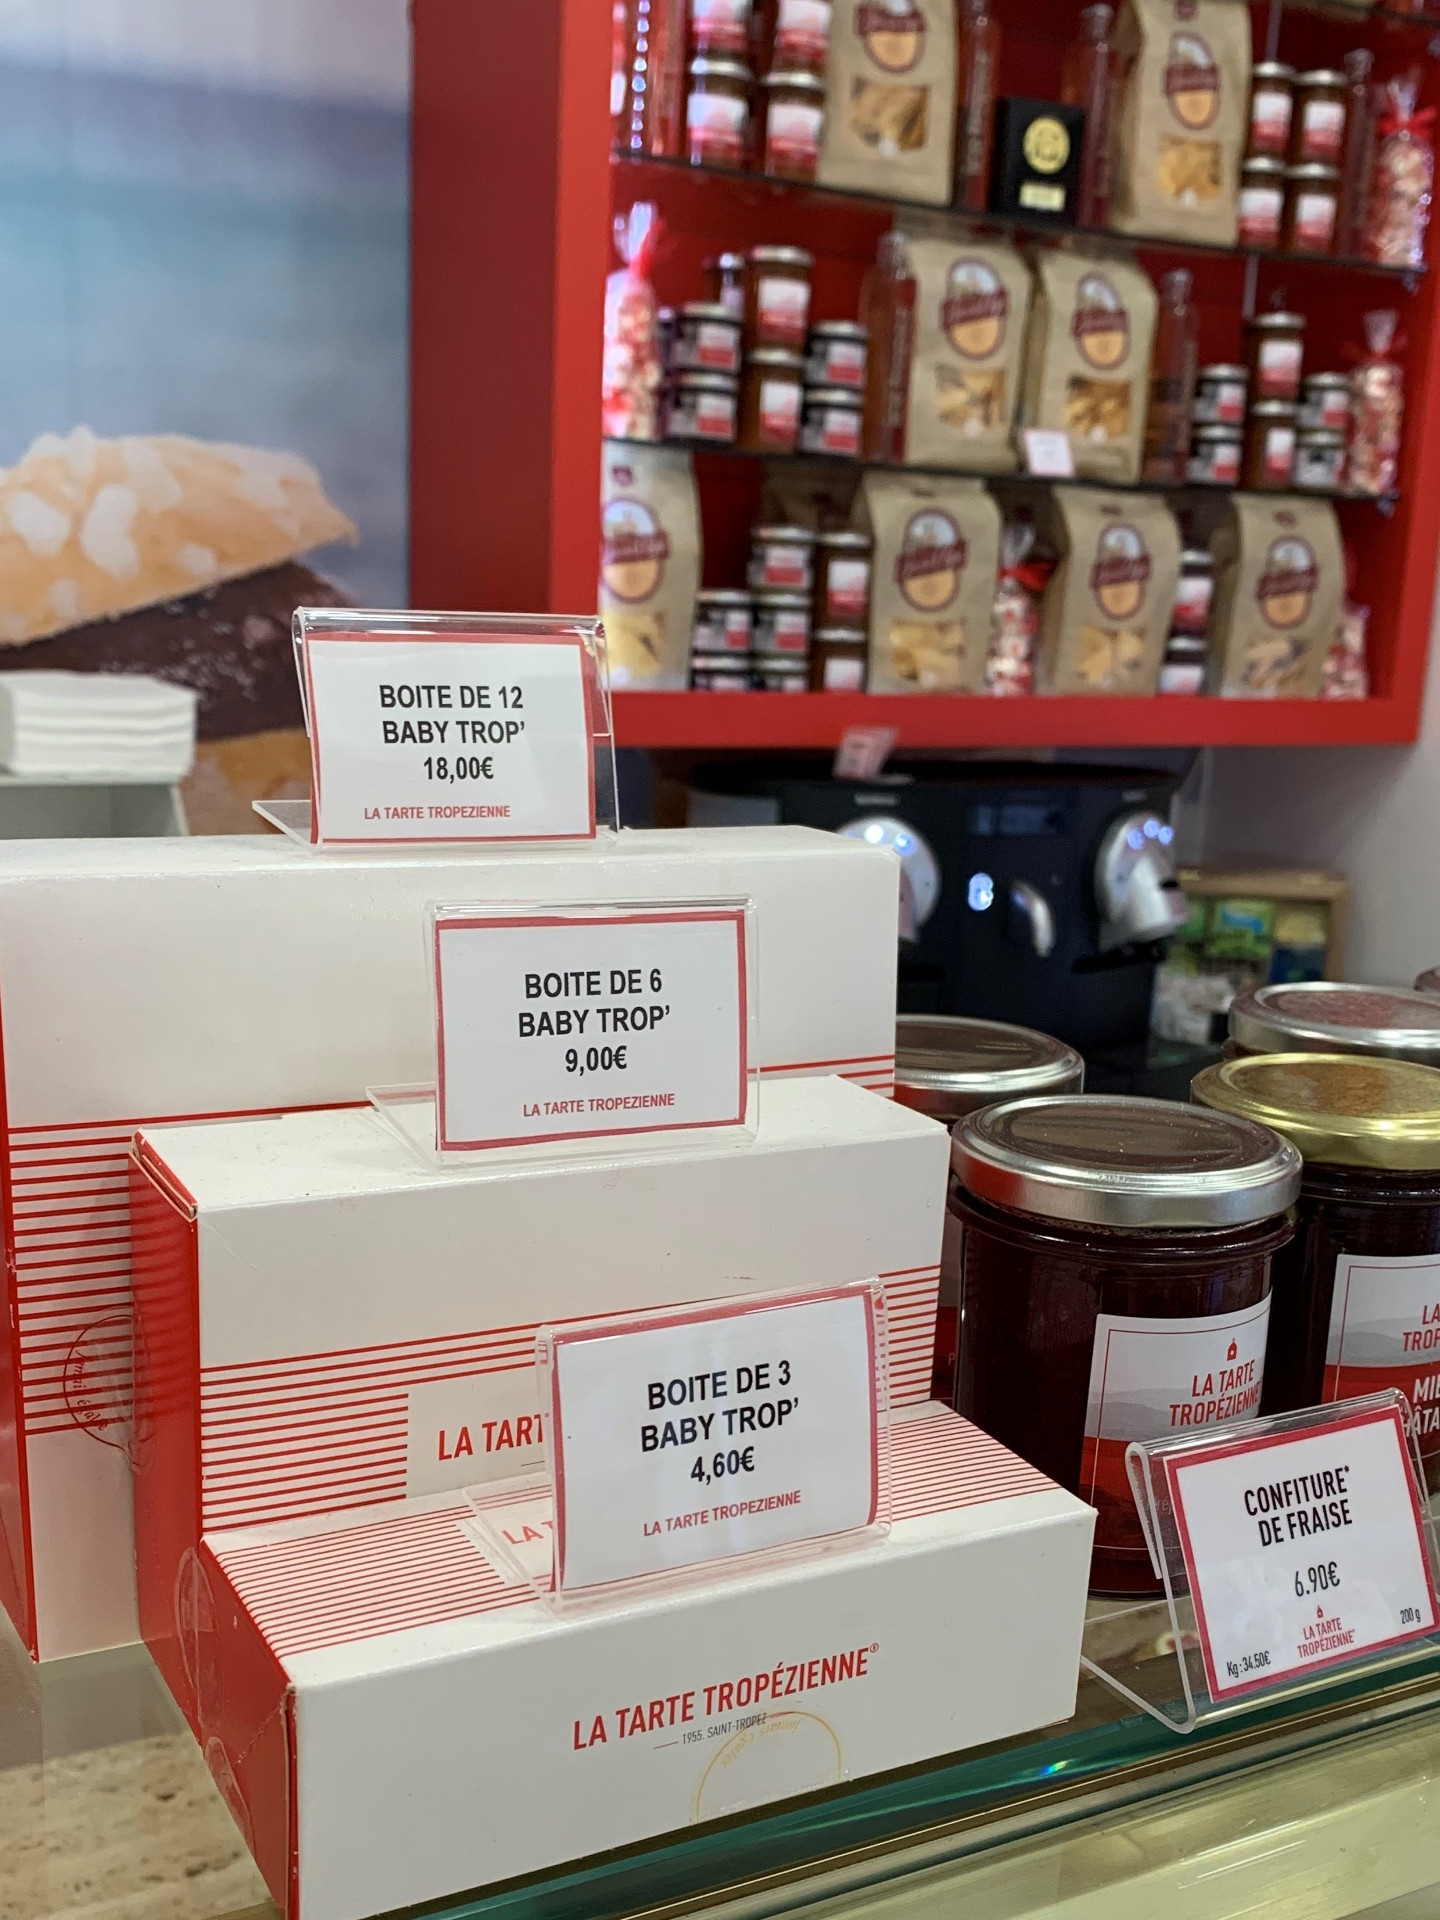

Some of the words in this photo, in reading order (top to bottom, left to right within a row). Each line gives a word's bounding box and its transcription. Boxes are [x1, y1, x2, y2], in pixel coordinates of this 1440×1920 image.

[379, 684, 452, 709] BOITE
[459, 685, 491, 709] DE
[498, 685, 524, 709] 12
[383, 720, 449, 744] BABY
[423, 756, 495, 784] 18,00€
[364, 807, 381, 820] LA
[384, 806, 424, 820] TARTE
[427, 805, 511, 819] TROPEZIENNE
[524, 971, 601, 999] BOITE
[609, 969, 643, 995] DE
[649, 968, 663, 993] 6
[518, 1009, 589, 1038] BABY
[564, 1045, 628, 1077] 9,00€
[523, 1103, 541, 1117] LA
[543, 1100, 584, 1115] TARTE
[587, 1093, 675, 1112] TROPEZIENNE
[647, 1370, 728, 1410] BOITE
[736, 1363, 771, 1395] DE
[777, 1359, 792, 1386] 3
[1192, 1373, 1214, 1397] LA
[1219, 1359, 1256, 1393] TARTE
[438, 1425, 474, 1461] LA
[481, 1413, 543, 1453] TART
[640, 1412, 716, 1452] BABY
[1404, 1406, 1440, 1438] HÂTA
[691, 1445, 756, 1485] 4,60€
[643, 1521, 662, 1537] LA
[665, 1509, 709, 1532] TARTE
[711, 1490, 802, 1522] TROPEZIENNE
[1257, 1516, 1285, 1547] DE
[1286, 1499, 1353, 1540] FRAISE
[502, 1525, 545, 1545] LA
[1294, 1561, 1341, 1597] 6.90€
[1303, 1626, 1315, 1641] LA
[1315, 1617, 1343, 1638] TARTE
[1400, 1609, 1414, 1625] 200
[1415, 1609, 1421, 1623] g
[572, 1715, 608, 1751] LA
[615, 1691, 696, 1739] TARTE
[707, 1712, 768, 1741] SAINT-TROPEZ
